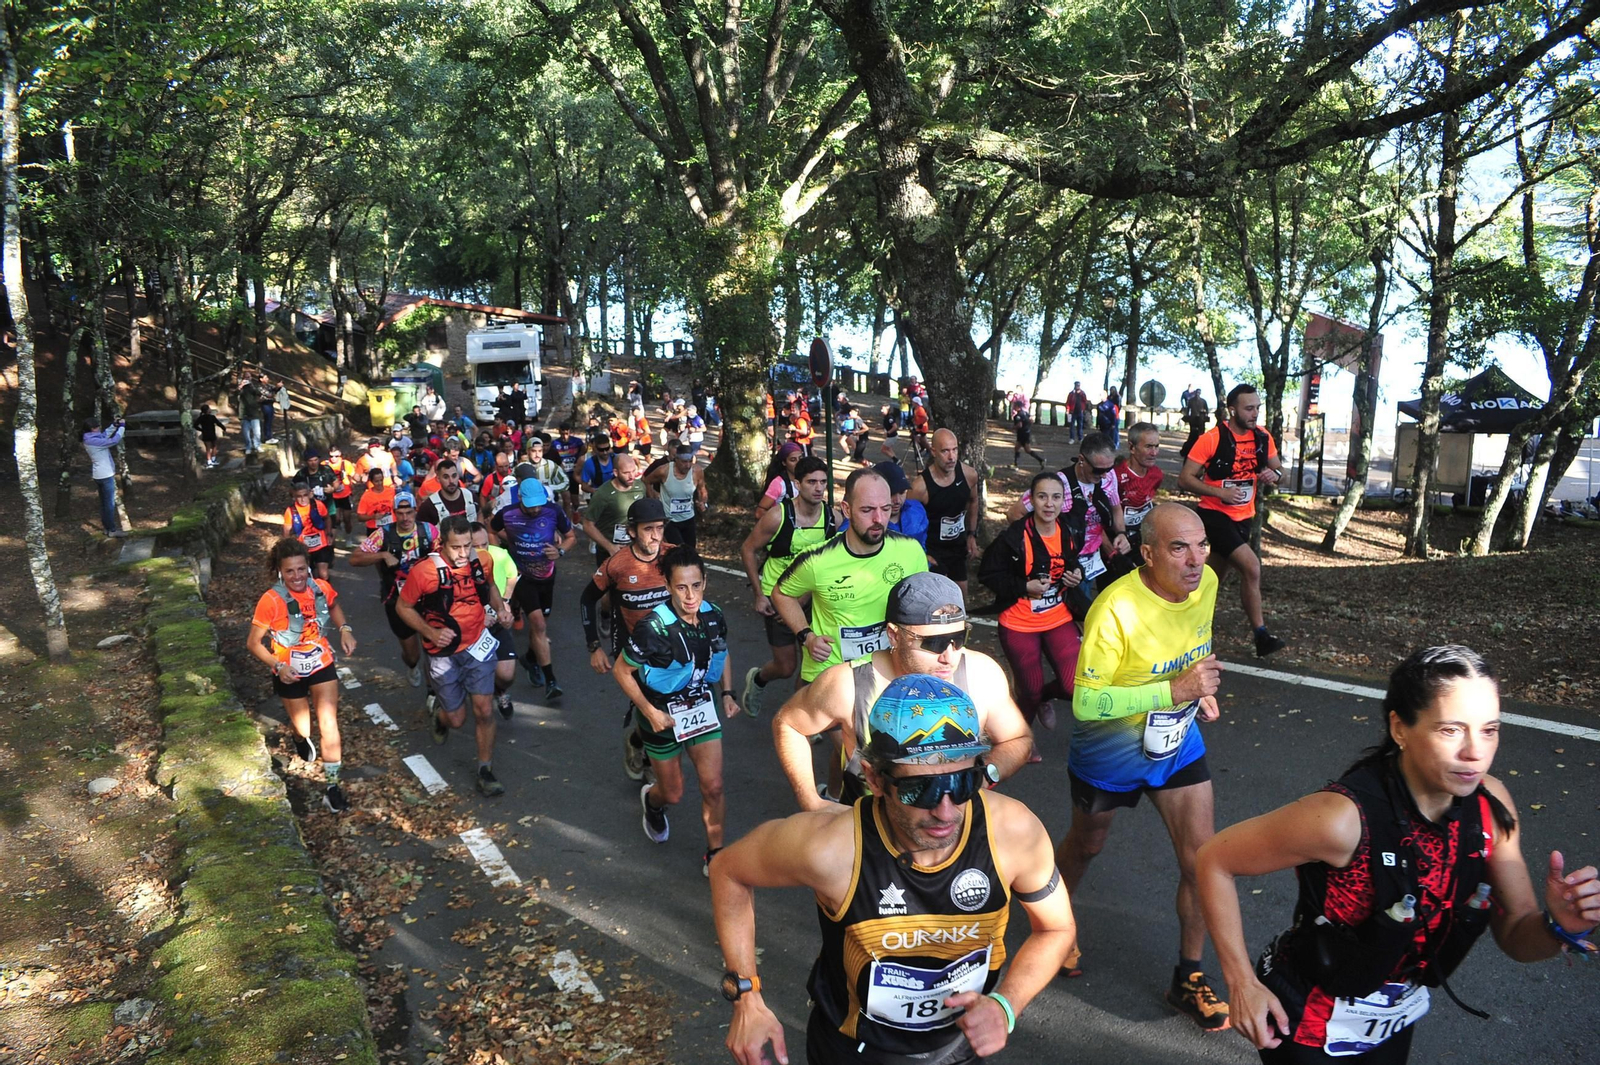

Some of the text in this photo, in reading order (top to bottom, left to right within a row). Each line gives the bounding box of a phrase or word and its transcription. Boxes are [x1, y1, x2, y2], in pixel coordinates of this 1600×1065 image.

[478, 636, 494, 654] 109
[857, 640, 881, 655] 161
[681, 711, 707, 730] 242
[1163, 724, 1188, 748] 140
[881, 922, 980, 950] OURENSE
[882, 967, 906, 977] TRAIL
